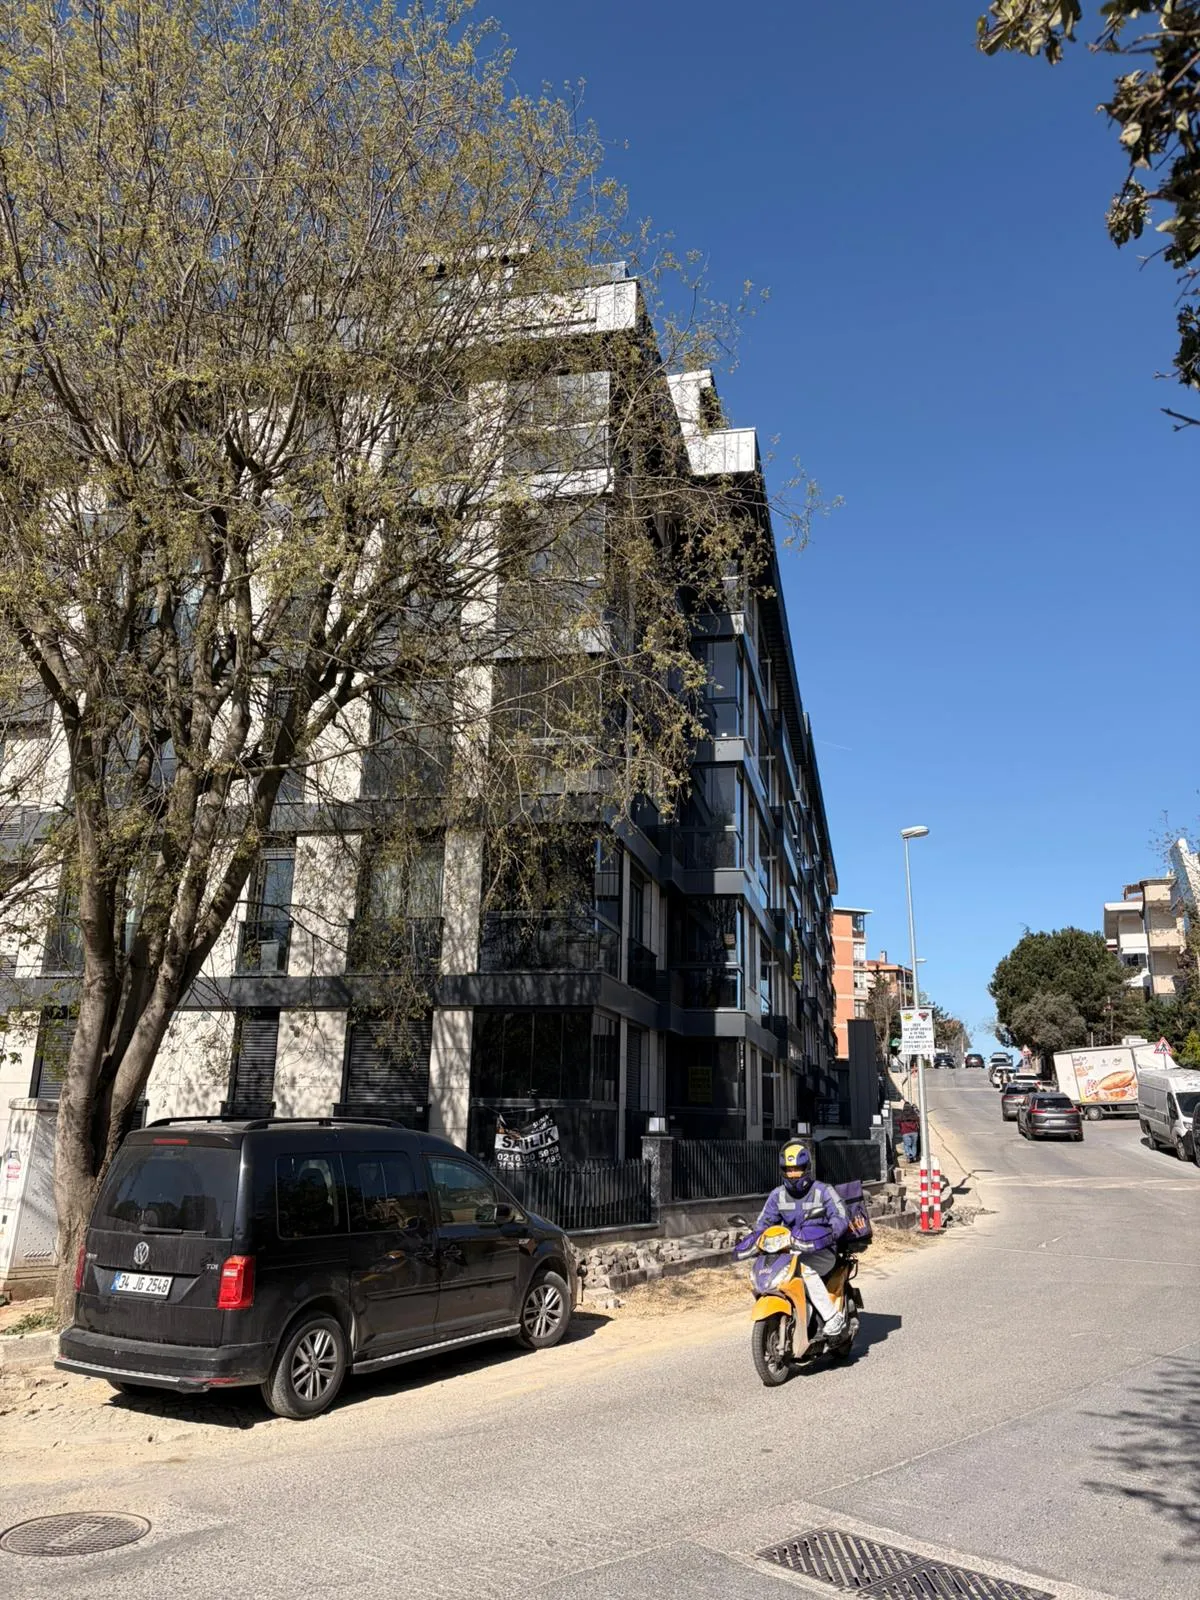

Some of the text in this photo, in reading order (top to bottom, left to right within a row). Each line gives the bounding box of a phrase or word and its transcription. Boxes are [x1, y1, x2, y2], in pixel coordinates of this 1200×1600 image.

[497, 1153, 521, 1162] 0216
[119, 1275, 130, 1289] 34
[146, 1278, 169, 1293] 2548
